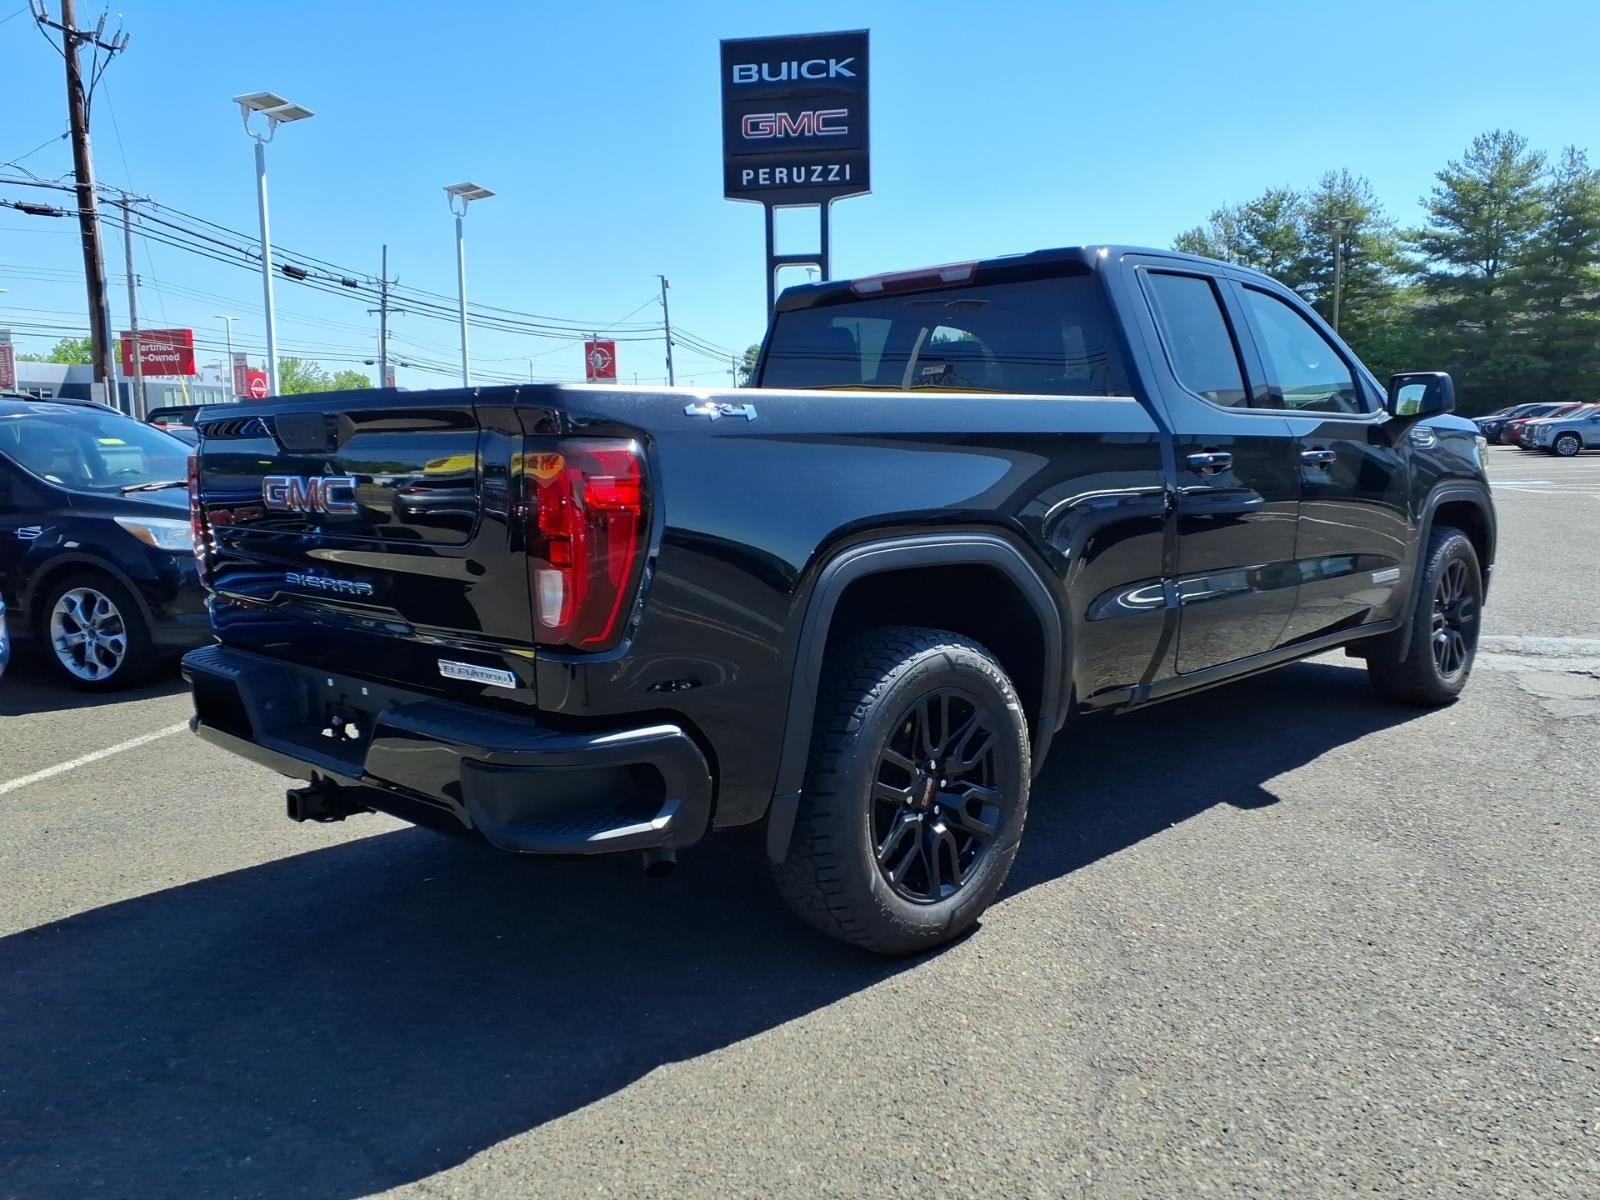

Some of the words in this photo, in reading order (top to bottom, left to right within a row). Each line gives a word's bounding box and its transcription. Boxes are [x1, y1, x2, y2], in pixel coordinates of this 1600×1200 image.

[733, 57, 857, 84] BUICK
[742, 108, 848, 139] GMC
[742, 164, 850, 185] PERUZZI
[129, 353, 180, 362] Pe-Owned
[262, 475, 359, 514] GMC
[286, 572, 373, 595] SIERRA
